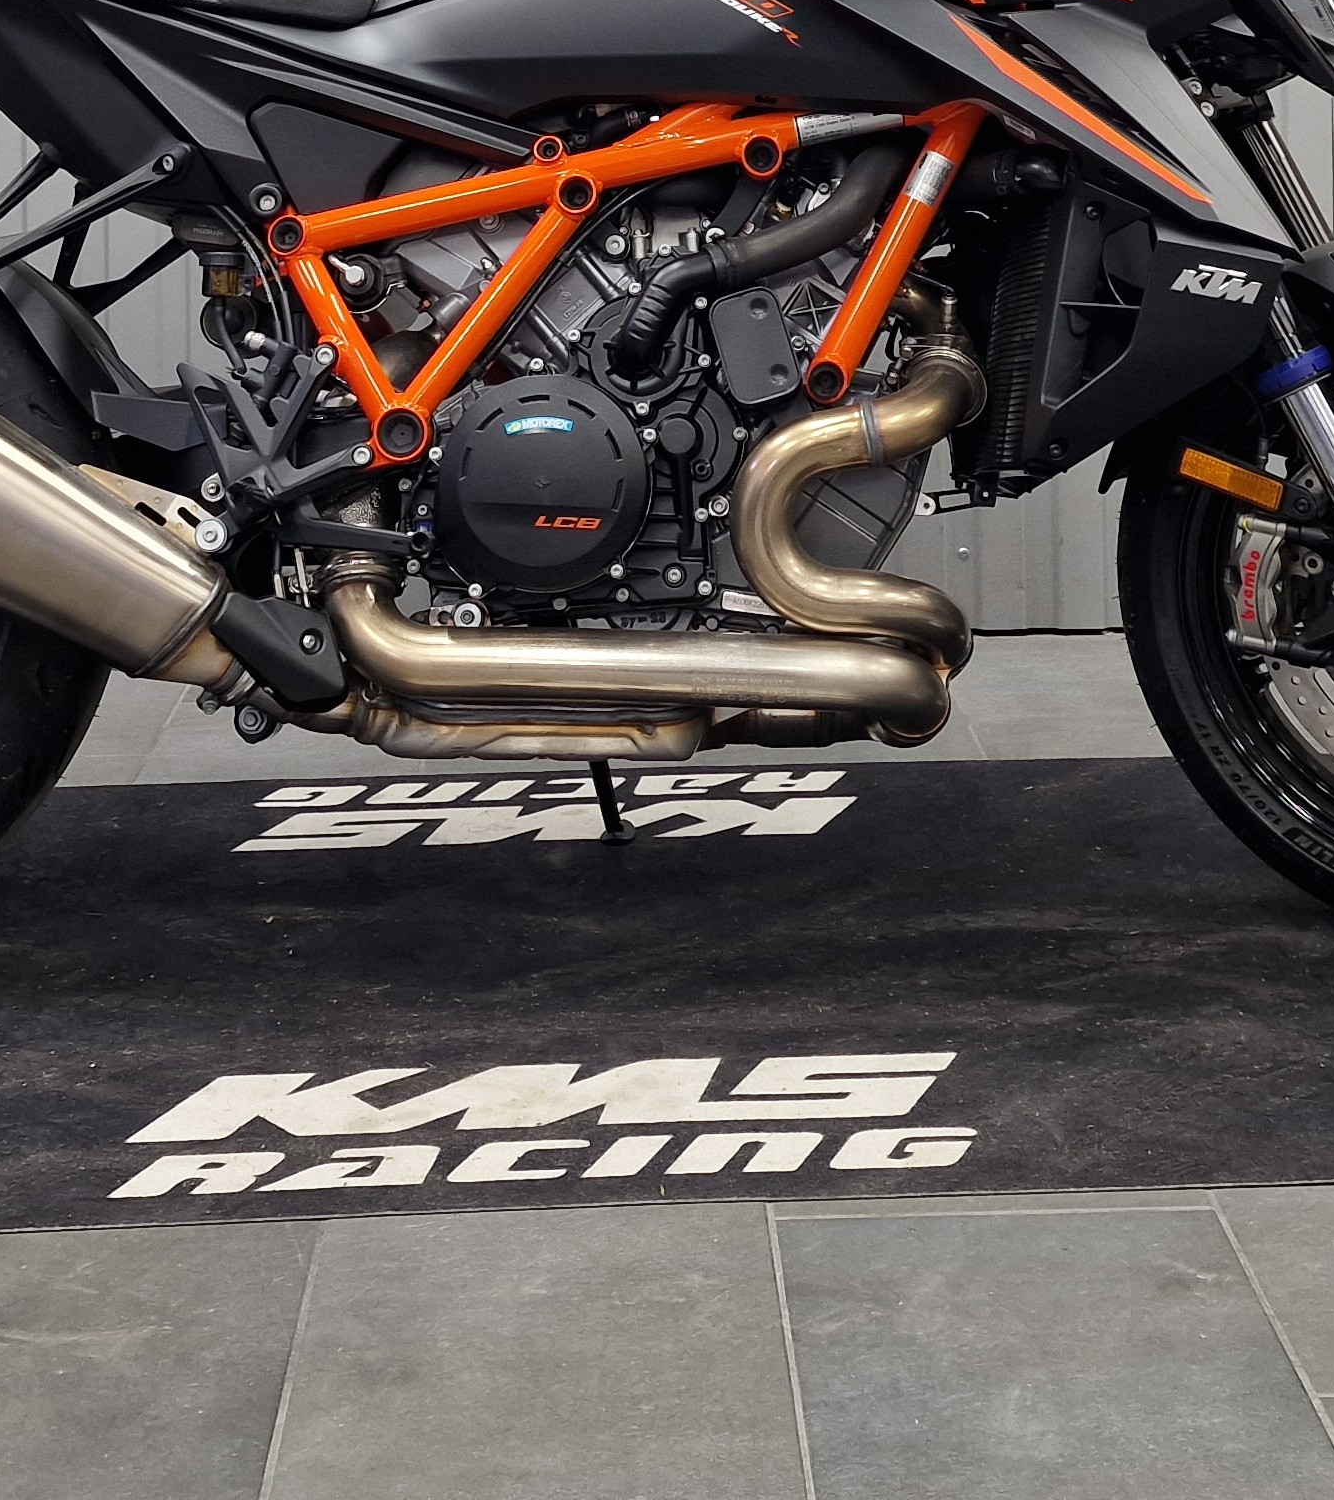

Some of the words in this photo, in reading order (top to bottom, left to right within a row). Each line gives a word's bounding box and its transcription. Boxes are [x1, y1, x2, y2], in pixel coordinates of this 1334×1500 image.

[1169, 263, 1264, 305] KTM
[521, 419, 569, 431] MOTOREX
[534, 515, 602, 529] LC8
[1242, 550, 1261, 620] brembo
[126, 1052, 957, 1143] KMS
[108, 1127, 978, 1198] RACING
